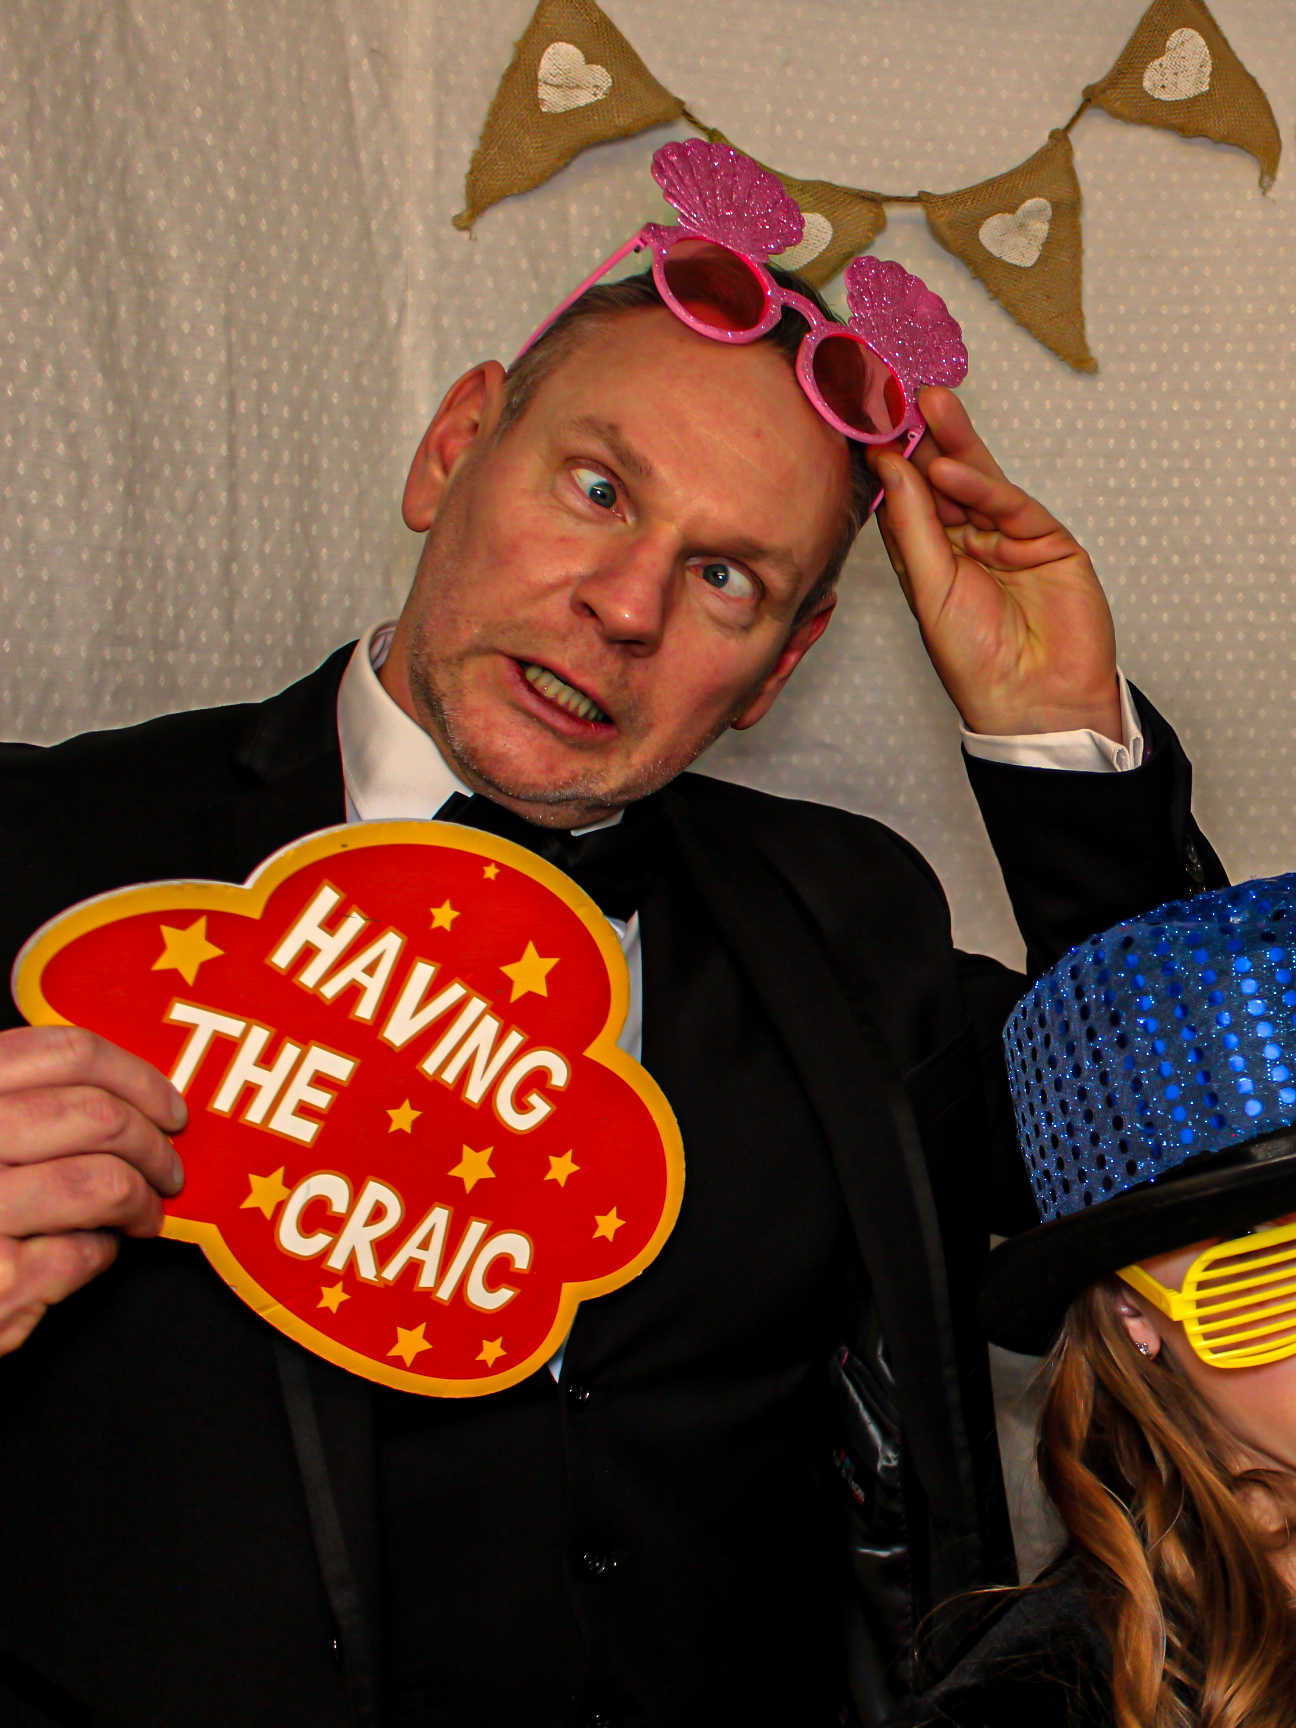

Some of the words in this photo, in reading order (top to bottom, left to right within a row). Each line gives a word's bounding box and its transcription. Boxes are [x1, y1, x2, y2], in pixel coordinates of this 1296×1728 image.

[169, 1002, 356, 1143] THE
[271, 884, 570, 1132] HAVING
[278, 1172, 532, 1311] CRAIC
